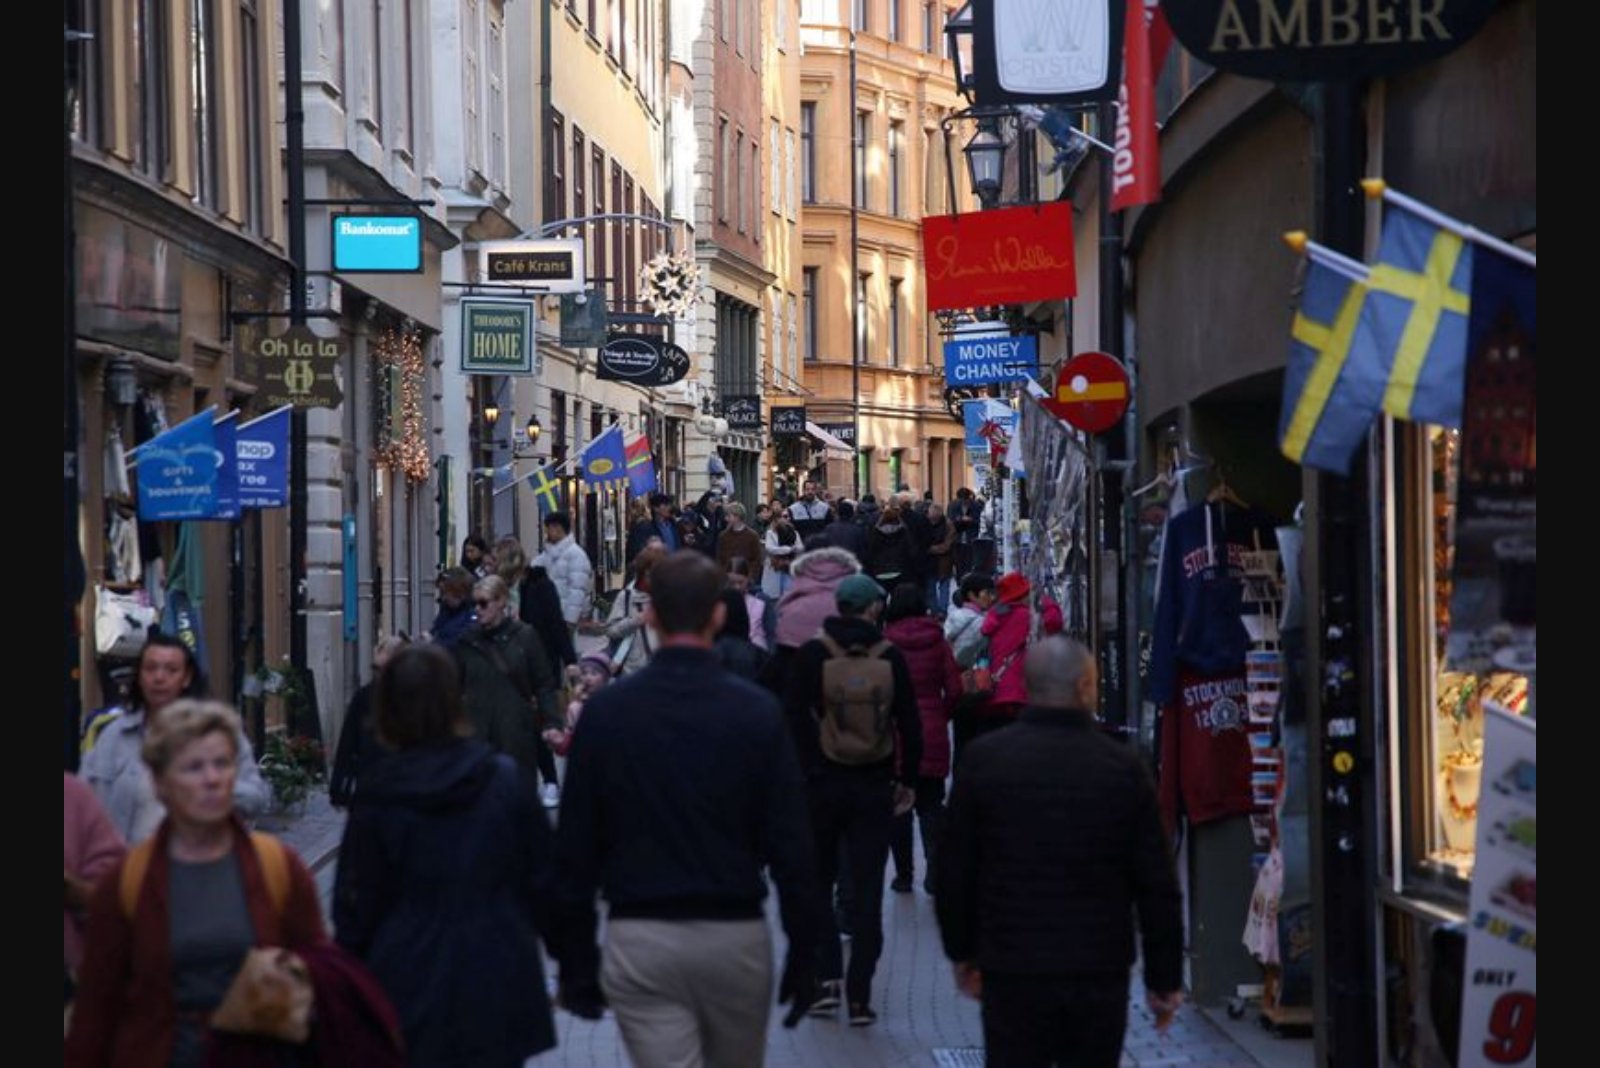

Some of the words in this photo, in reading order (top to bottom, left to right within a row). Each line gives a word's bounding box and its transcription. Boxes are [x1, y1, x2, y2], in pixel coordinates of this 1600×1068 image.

[1210, 0, 1453, 52] AMBER
[494, 259, 525, 274] Café
[528, 258, 567, 273] Krans
[260, 339, 288, 357] Oh
[294, 339, 314, 357] la
[318, 339, 338, 357] la
[473, 332, 521, 359] HOME
[959, 342, 1020, 361] MONEY
[954, 361, 1028, 381] CHANGE
[1473, 969, 1517, 985] ONLY
[1482, 991, 1536, 1066] 9
